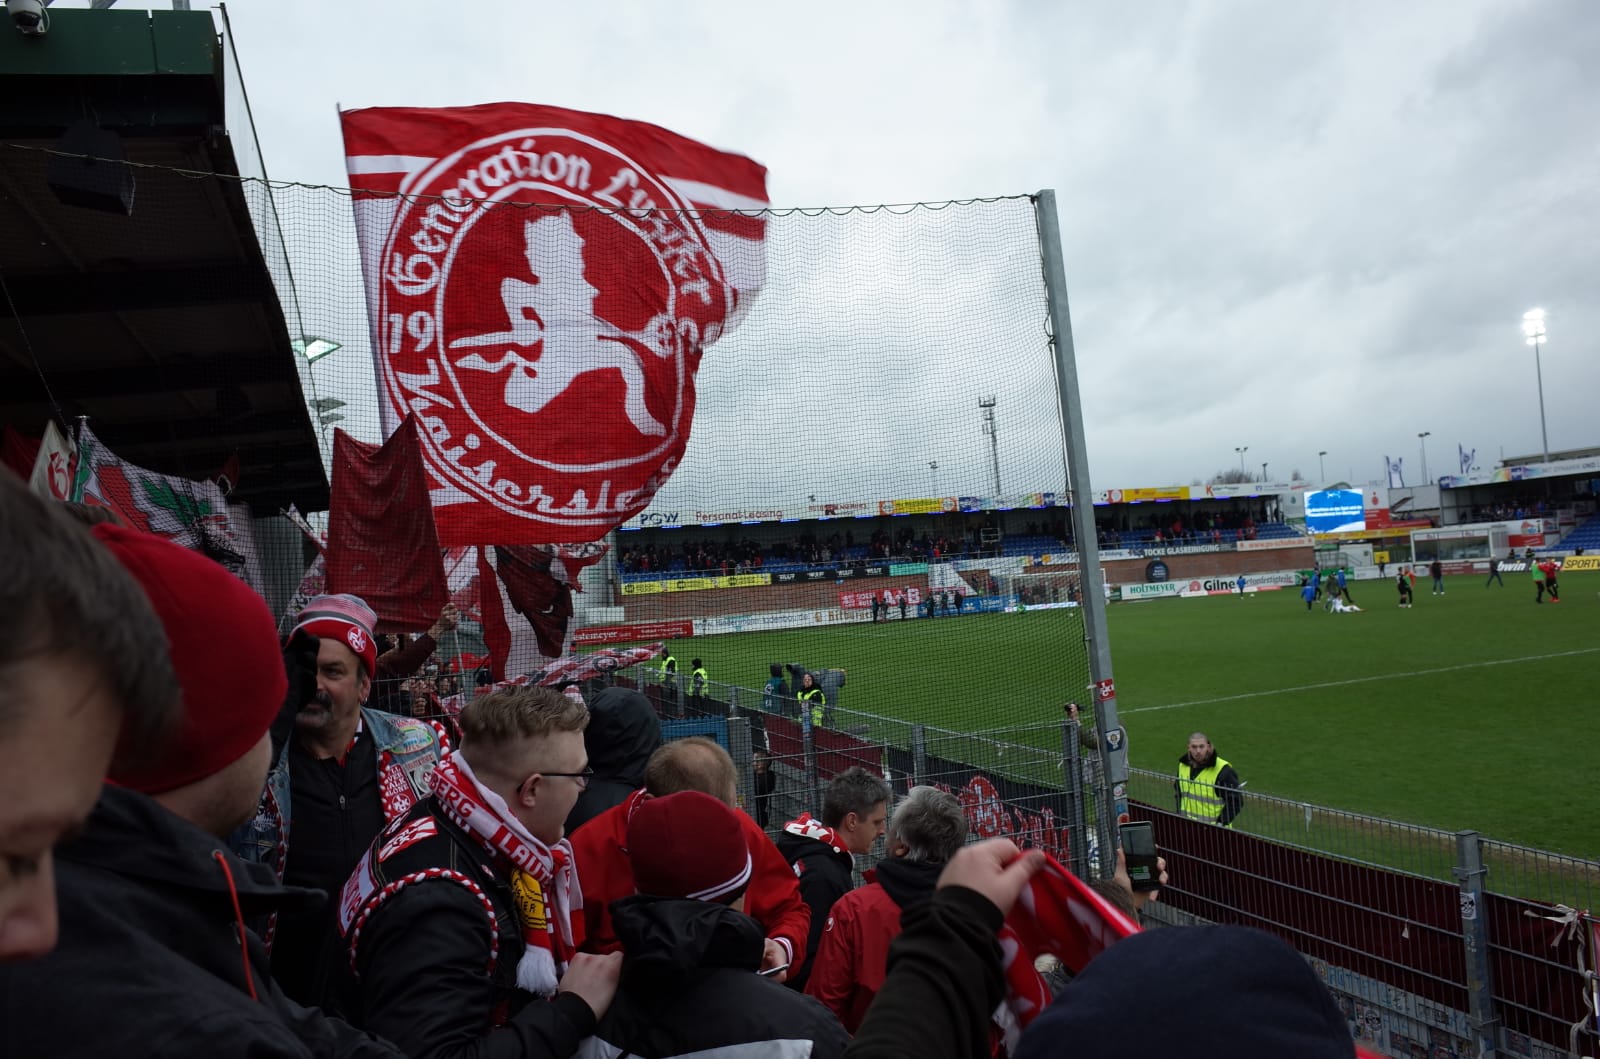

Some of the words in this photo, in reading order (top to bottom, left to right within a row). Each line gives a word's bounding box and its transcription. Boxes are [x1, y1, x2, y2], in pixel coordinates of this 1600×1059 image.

[387, 138, 591, 296] Generation
[388, 311, 435, 354] 19
[1497, 560, 1526, 572] bwin
[1130, 583, 1176, 594] HOLTMEYER
[1203, 579, 1236, 591] Gilne
